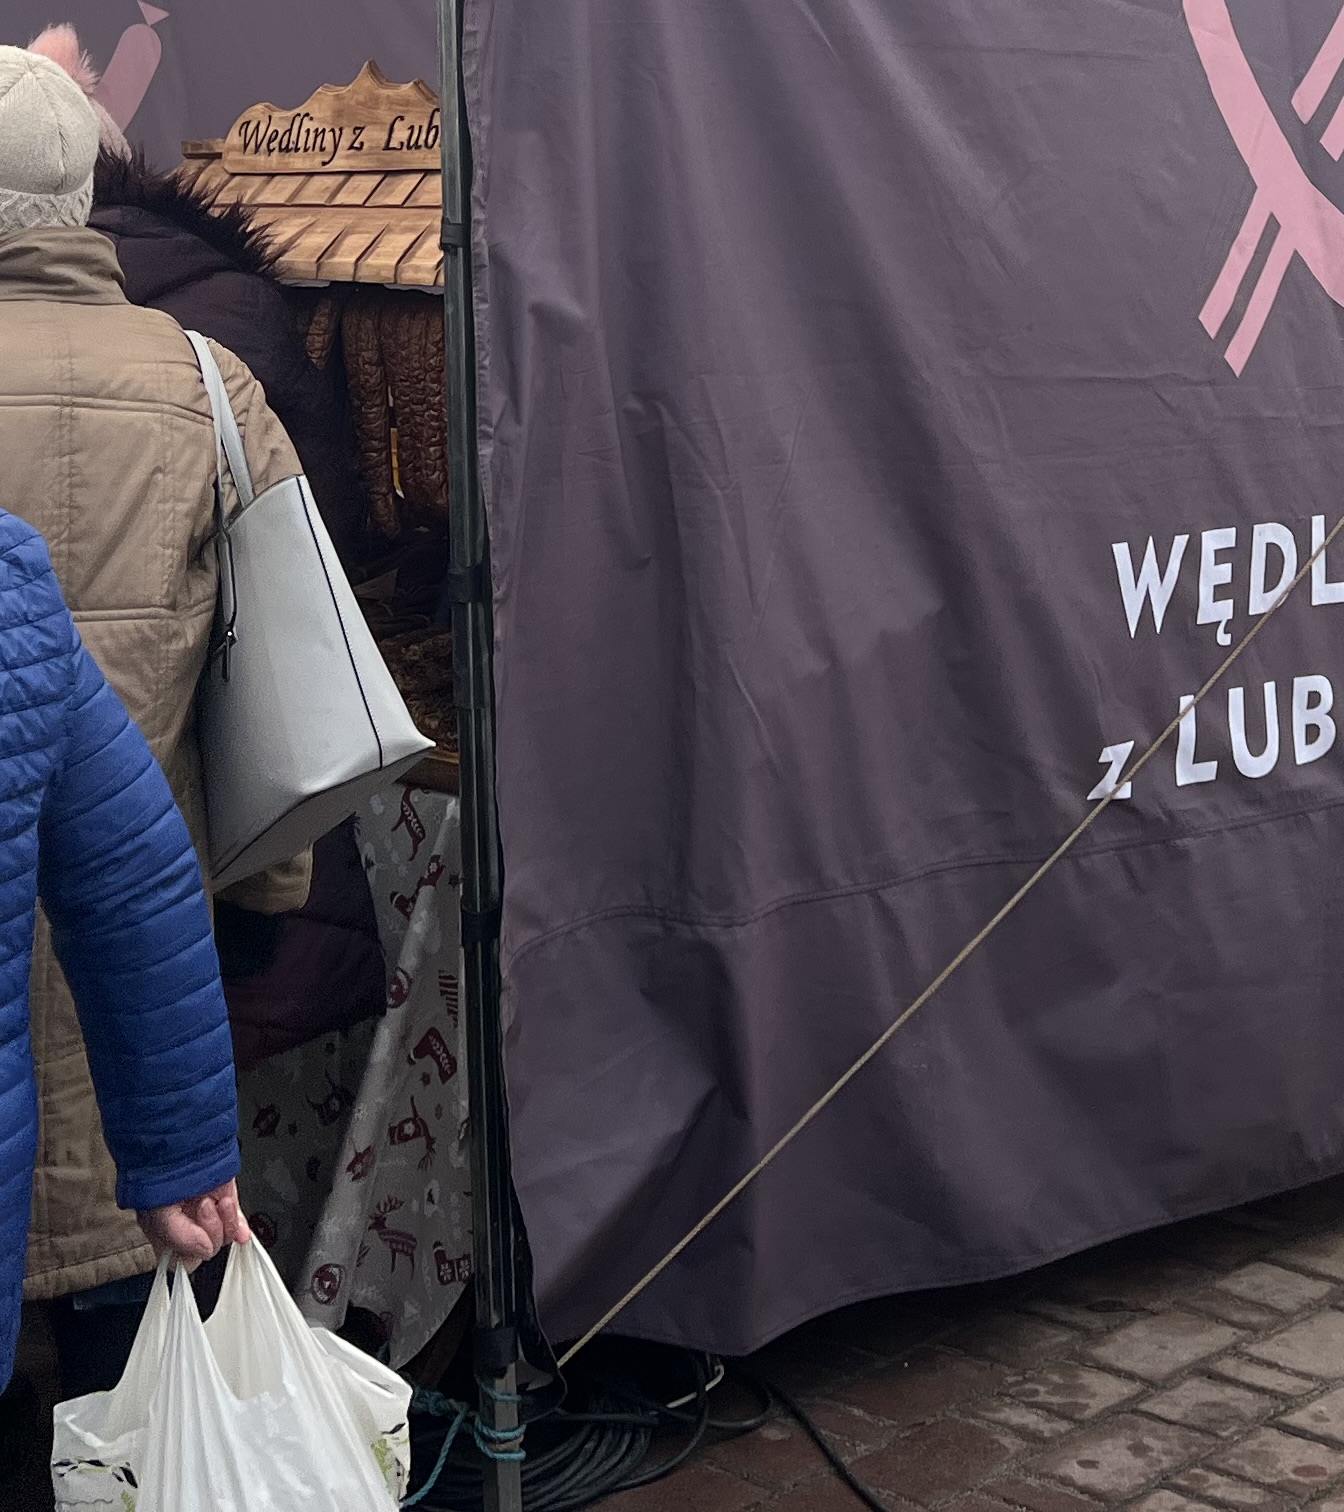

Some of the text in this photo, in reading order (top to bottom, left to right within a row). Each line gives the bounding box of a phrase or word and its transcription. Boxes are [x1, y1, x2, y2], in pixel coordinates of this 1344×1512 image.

[347, 125, 365, 152] z
[382, 107, 441, 152] Lub
[1086, 740, 1135, 801] z
